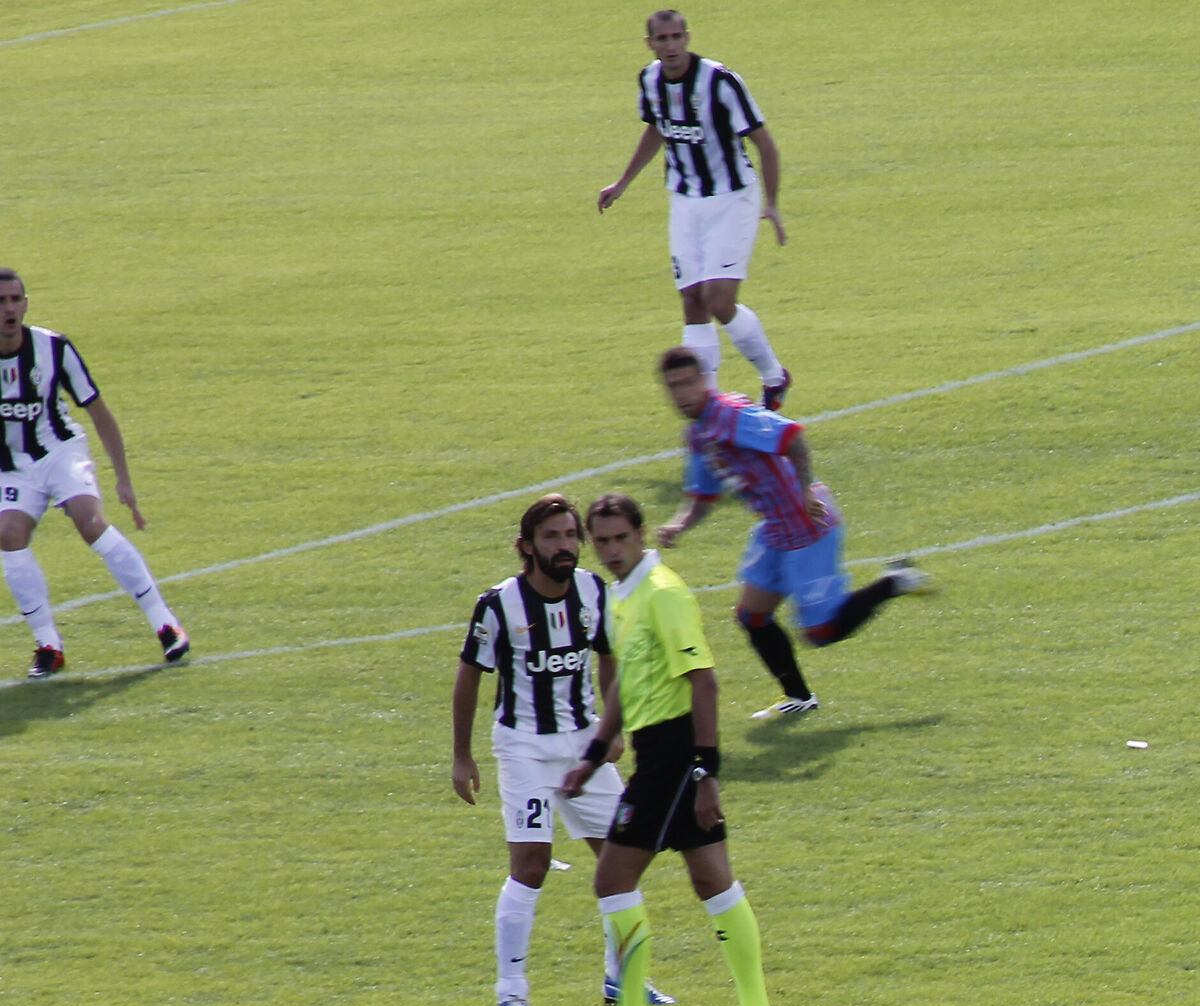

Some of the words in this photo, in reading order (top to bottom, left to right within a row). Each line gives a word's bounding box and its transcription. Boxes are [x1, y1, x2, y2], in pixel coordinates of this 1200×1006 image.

[658, 119, 704, 144] Jeep
[0, 401, 43, 421] eep
[0, 486, 19, 502] 9
[527, 649, 589, 672] Jeep
